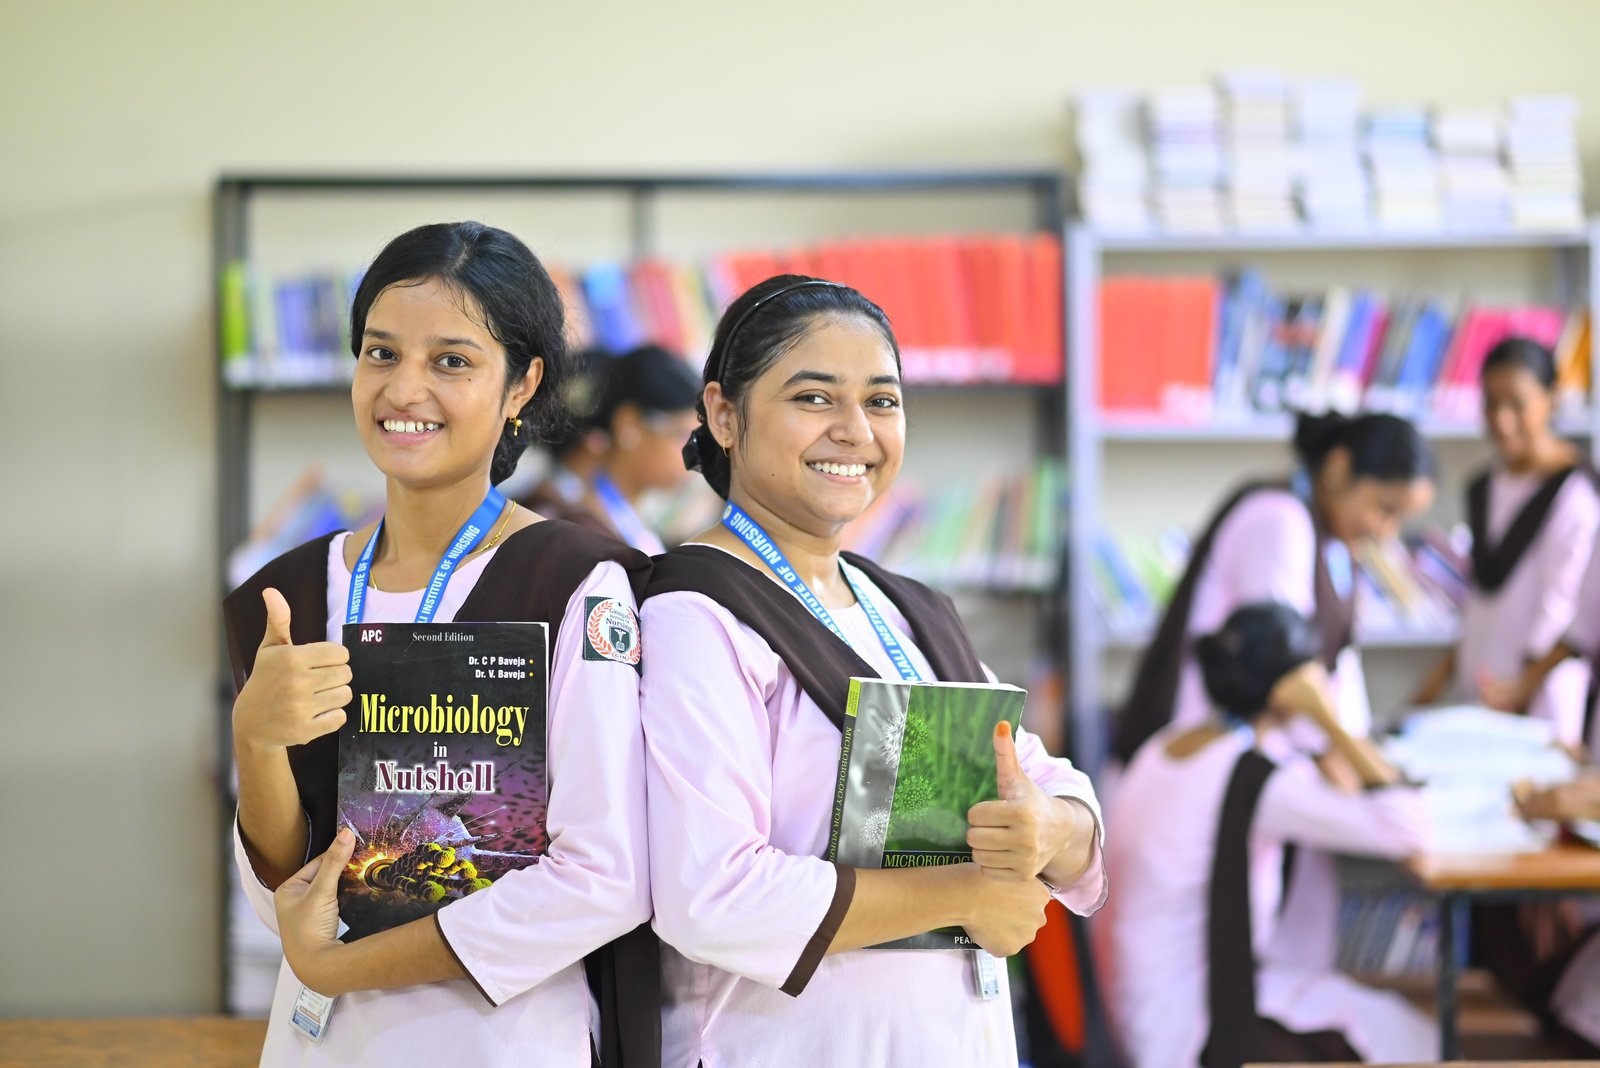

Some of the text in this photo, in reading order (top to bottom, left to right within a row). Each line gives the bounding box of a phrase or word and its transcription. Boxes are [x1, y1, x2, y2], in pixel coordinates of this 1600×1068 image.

[730, 512, 782, 564] NURSING
[357, 562, 368, 572] OF
[422, 571, 447, 615] INSTITUTE
[440, 559, 452, 570] OF
[450, 524, 481, 559] NURSING
[776, 566, 796, 582] OF
[350, 573, 365, 615] INSTITUTE
[361, 629, 383, 643] APC
[412, 632, 474, 642] Second Edition
[469, 656, 526, 668] Dr. C P Baveja
[475, 669, 526, 680] Dr. V. Baveja
[359, 693, 530, 747] Microbiology
[433, 741, 448, 758] in
[837, 726, 852, 806] MICROBIOLOGY
[376, 761, 494, 793] Nutshell
[833, 807, 841, 827] FOR
